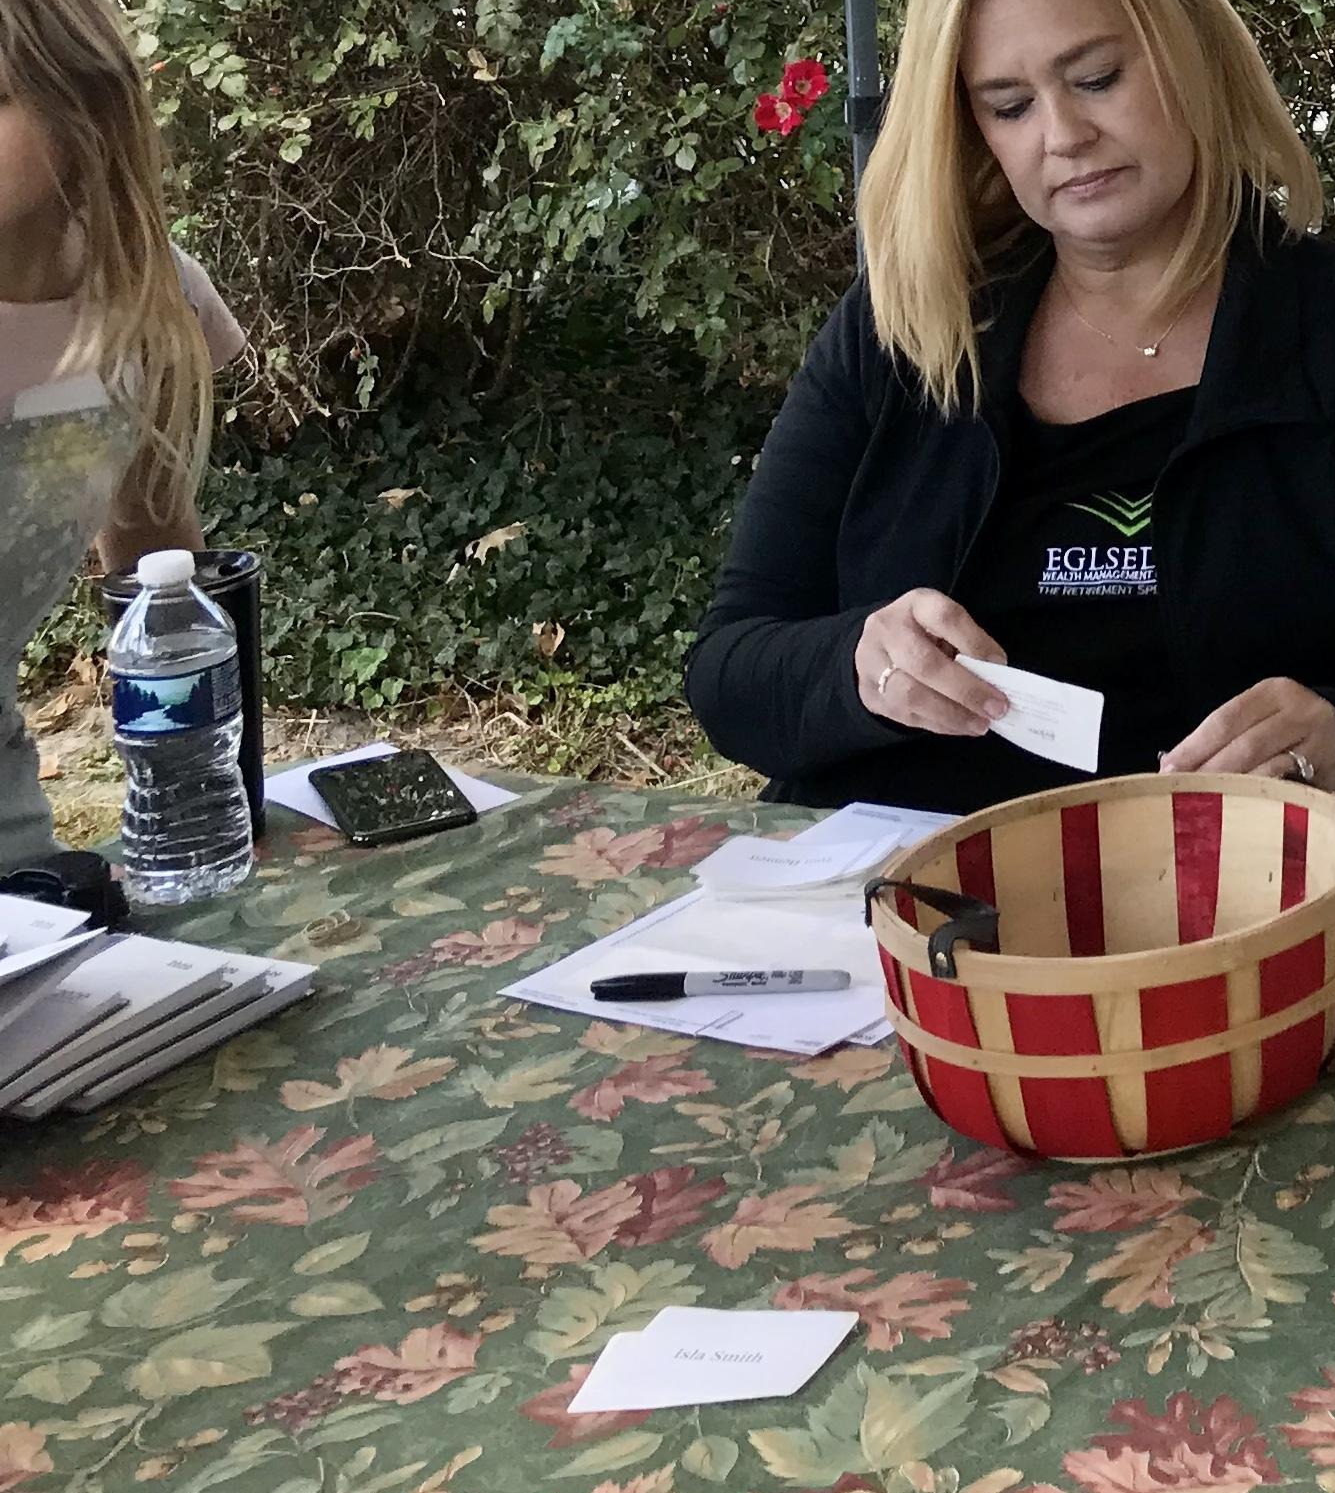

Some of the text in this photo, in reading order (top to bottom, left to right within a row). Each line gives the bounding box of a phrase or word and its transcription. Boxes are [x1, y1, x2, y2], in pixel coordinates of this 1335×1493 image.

[1042, 570, 1154, 582] WEALTH MANAGEMENT
[713, 1350, 763, 1364] Smith
